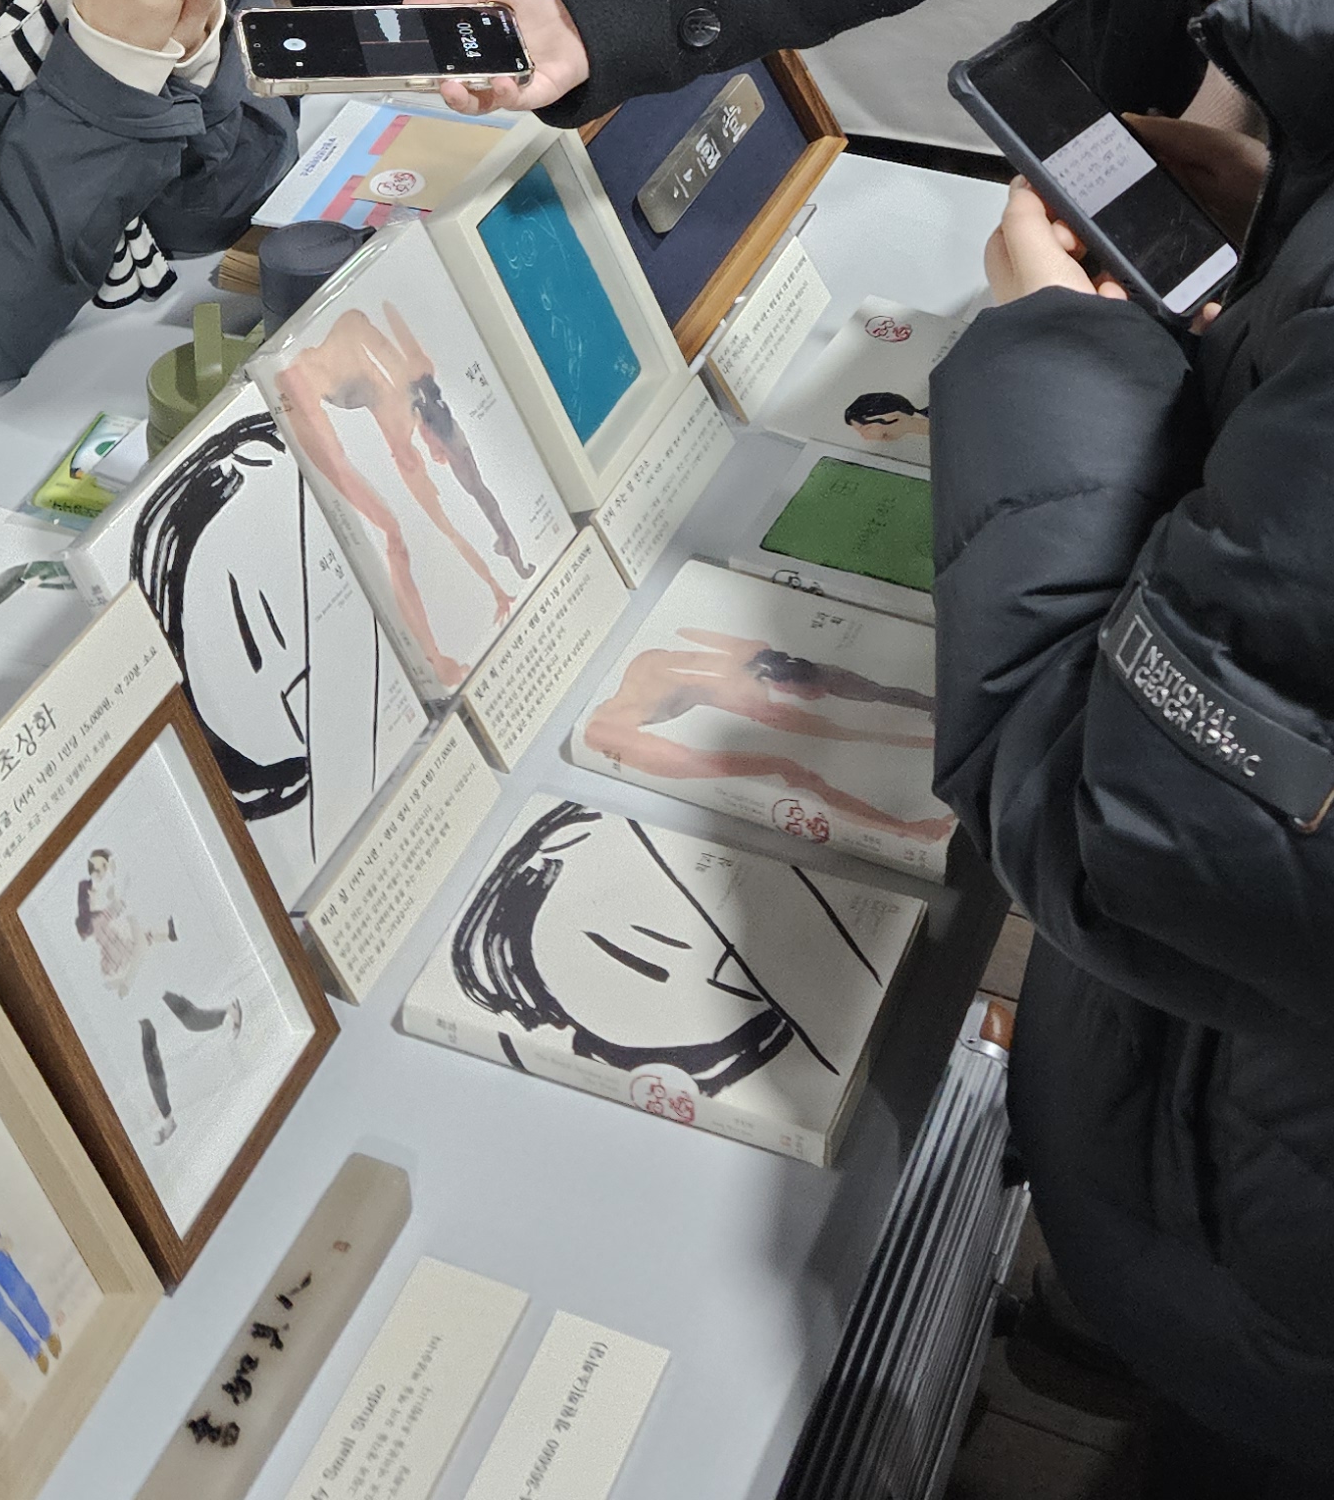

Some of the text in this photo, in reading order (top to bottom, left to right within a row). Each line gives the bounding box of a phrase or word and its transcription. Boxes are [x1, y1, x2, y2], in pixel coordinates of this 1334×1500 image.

[142, 645, 158, 666] 소요
[1143, 645, 1237, 739] NATIONAL
[1134, 666, 1262, 777] GEOGRAPHIC
[322, 1436, 355, 1480] Small
[350, 1384, 386, 1430] Studio
